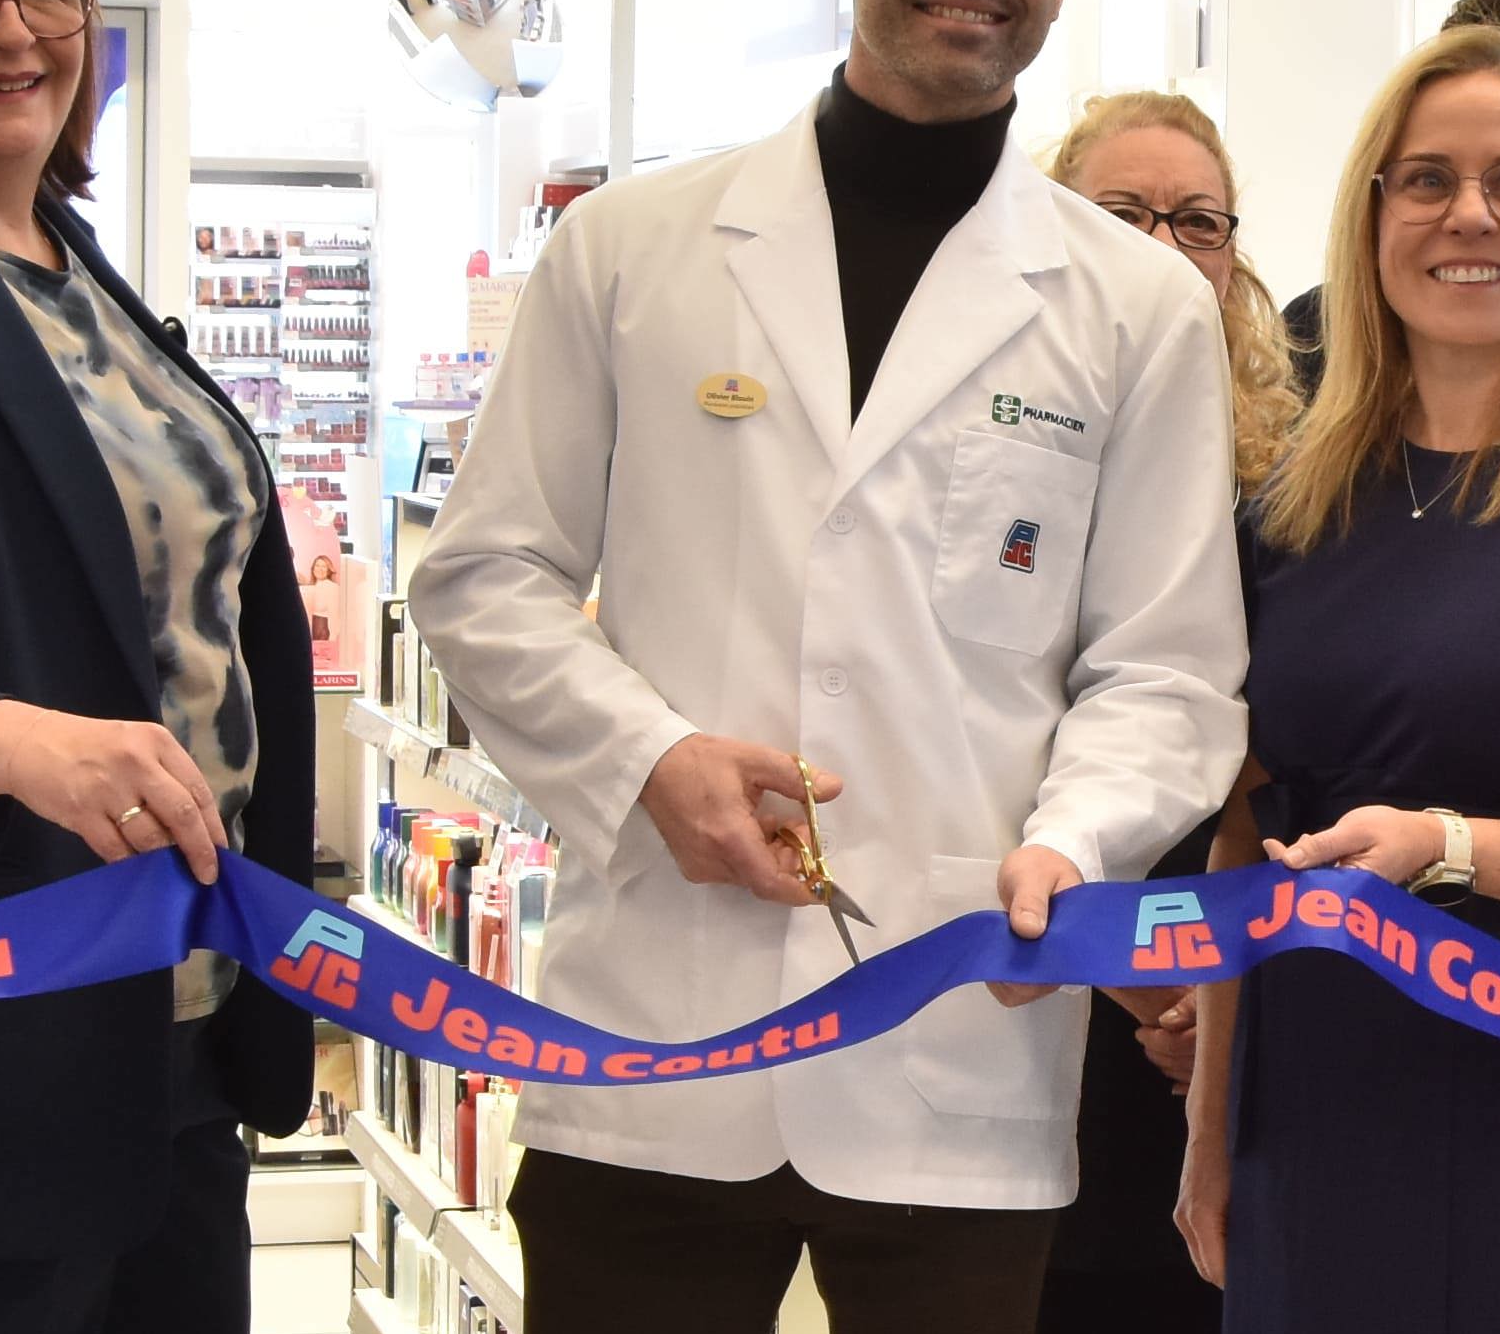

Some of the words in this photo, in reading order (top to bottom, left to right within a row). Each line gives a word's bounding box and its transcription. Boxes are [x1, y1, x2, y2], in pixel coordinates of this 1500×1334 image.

[1023, 406, 1086, 434] PHARMACIEN
[1246, 878, 1417, 976] Jean
[390, 977, 588, 1078] Jean
[602, 1011, 839, 1079] Coutu
